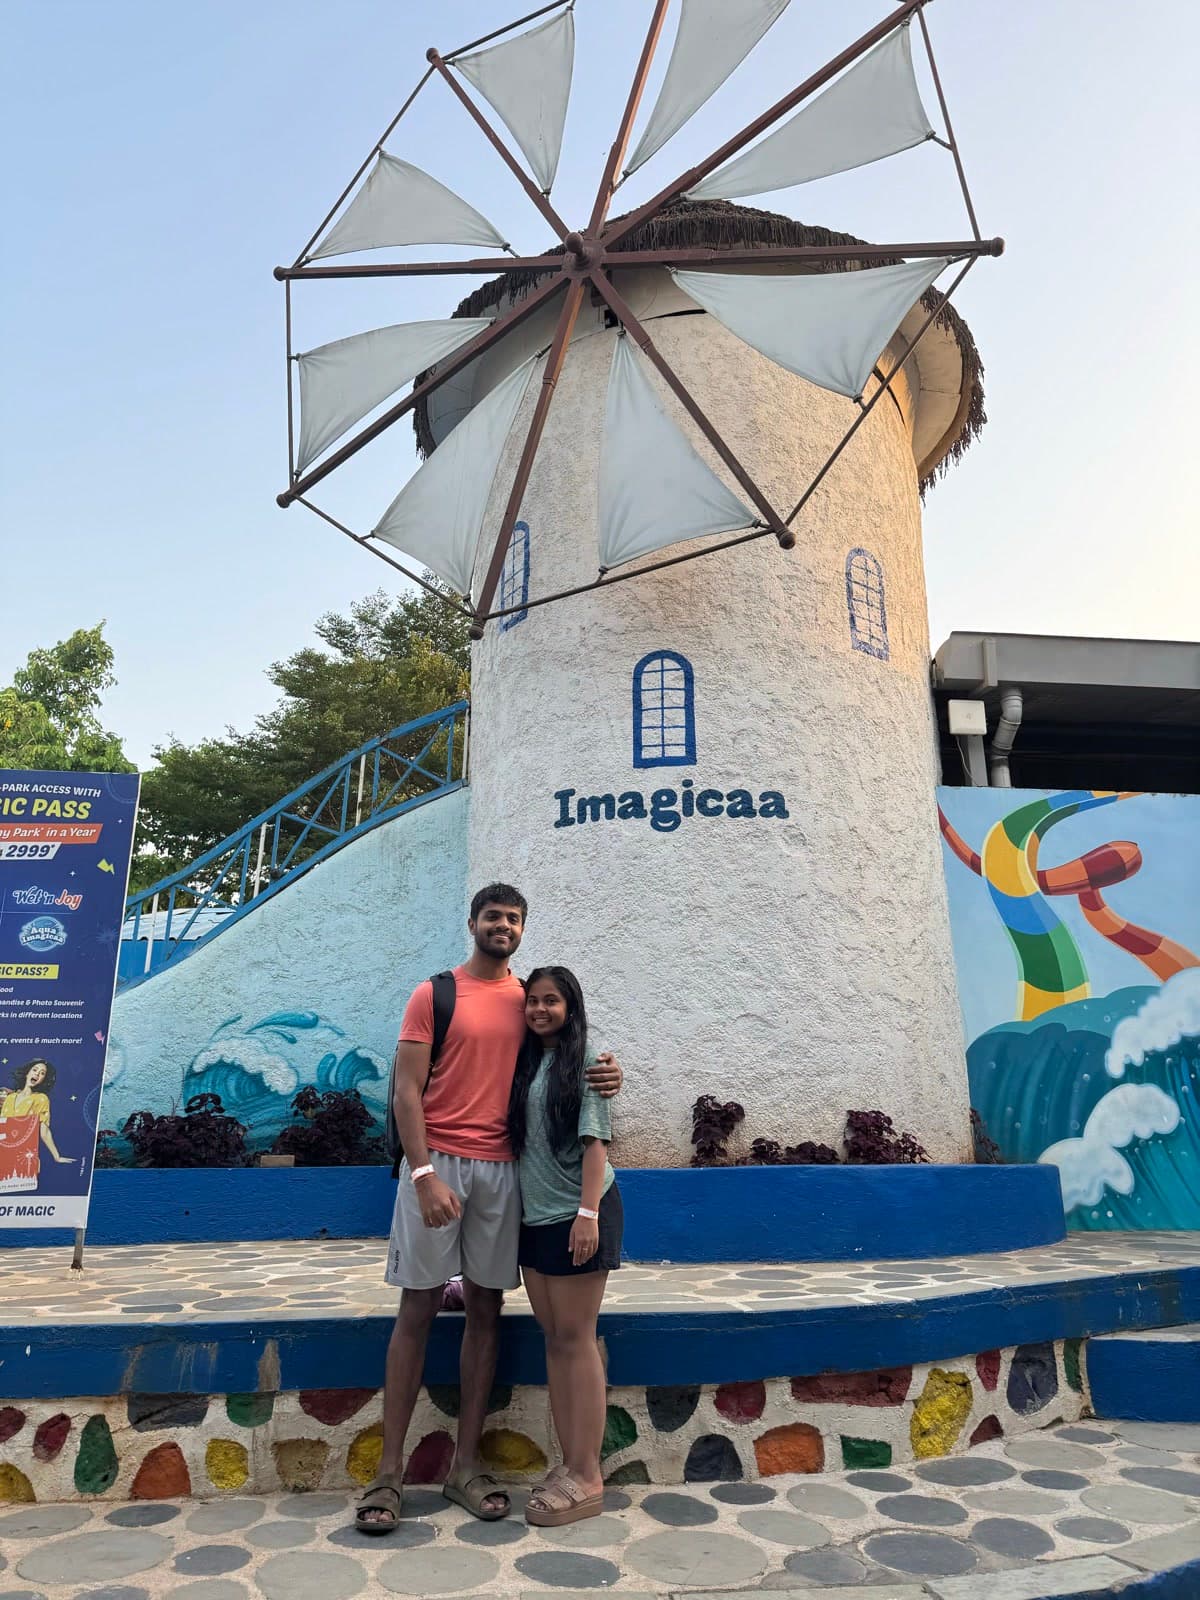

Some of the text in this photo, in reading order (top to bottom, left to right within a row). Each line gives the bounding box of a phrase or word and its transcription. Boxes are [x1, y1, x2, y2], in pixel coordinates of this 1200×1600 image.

[31, 784, 72, 795] ACCESS
[73, 786, 102, 798] WITH
[0, 797, 92, 819] IC PASS
[553, 778, 790, 832] Imagicaa
[46, 828, 57, 837] in
[60, 829, 67, 837] a
[69, 828, 97, 838] Year
[12, 885, 43, 905] Wet
[54, 888, 83, 911] Joy
[31, 926, 57, 936] Aqua
[0, 966, 50, 977] IC PASS?
[53, 999, 85, 1007] Souvenir
[18, 1011, 51, 1019] different
[61, 1037, 83, 1045] more!
[0, 1206, 56, 1217] OF MAGIC
